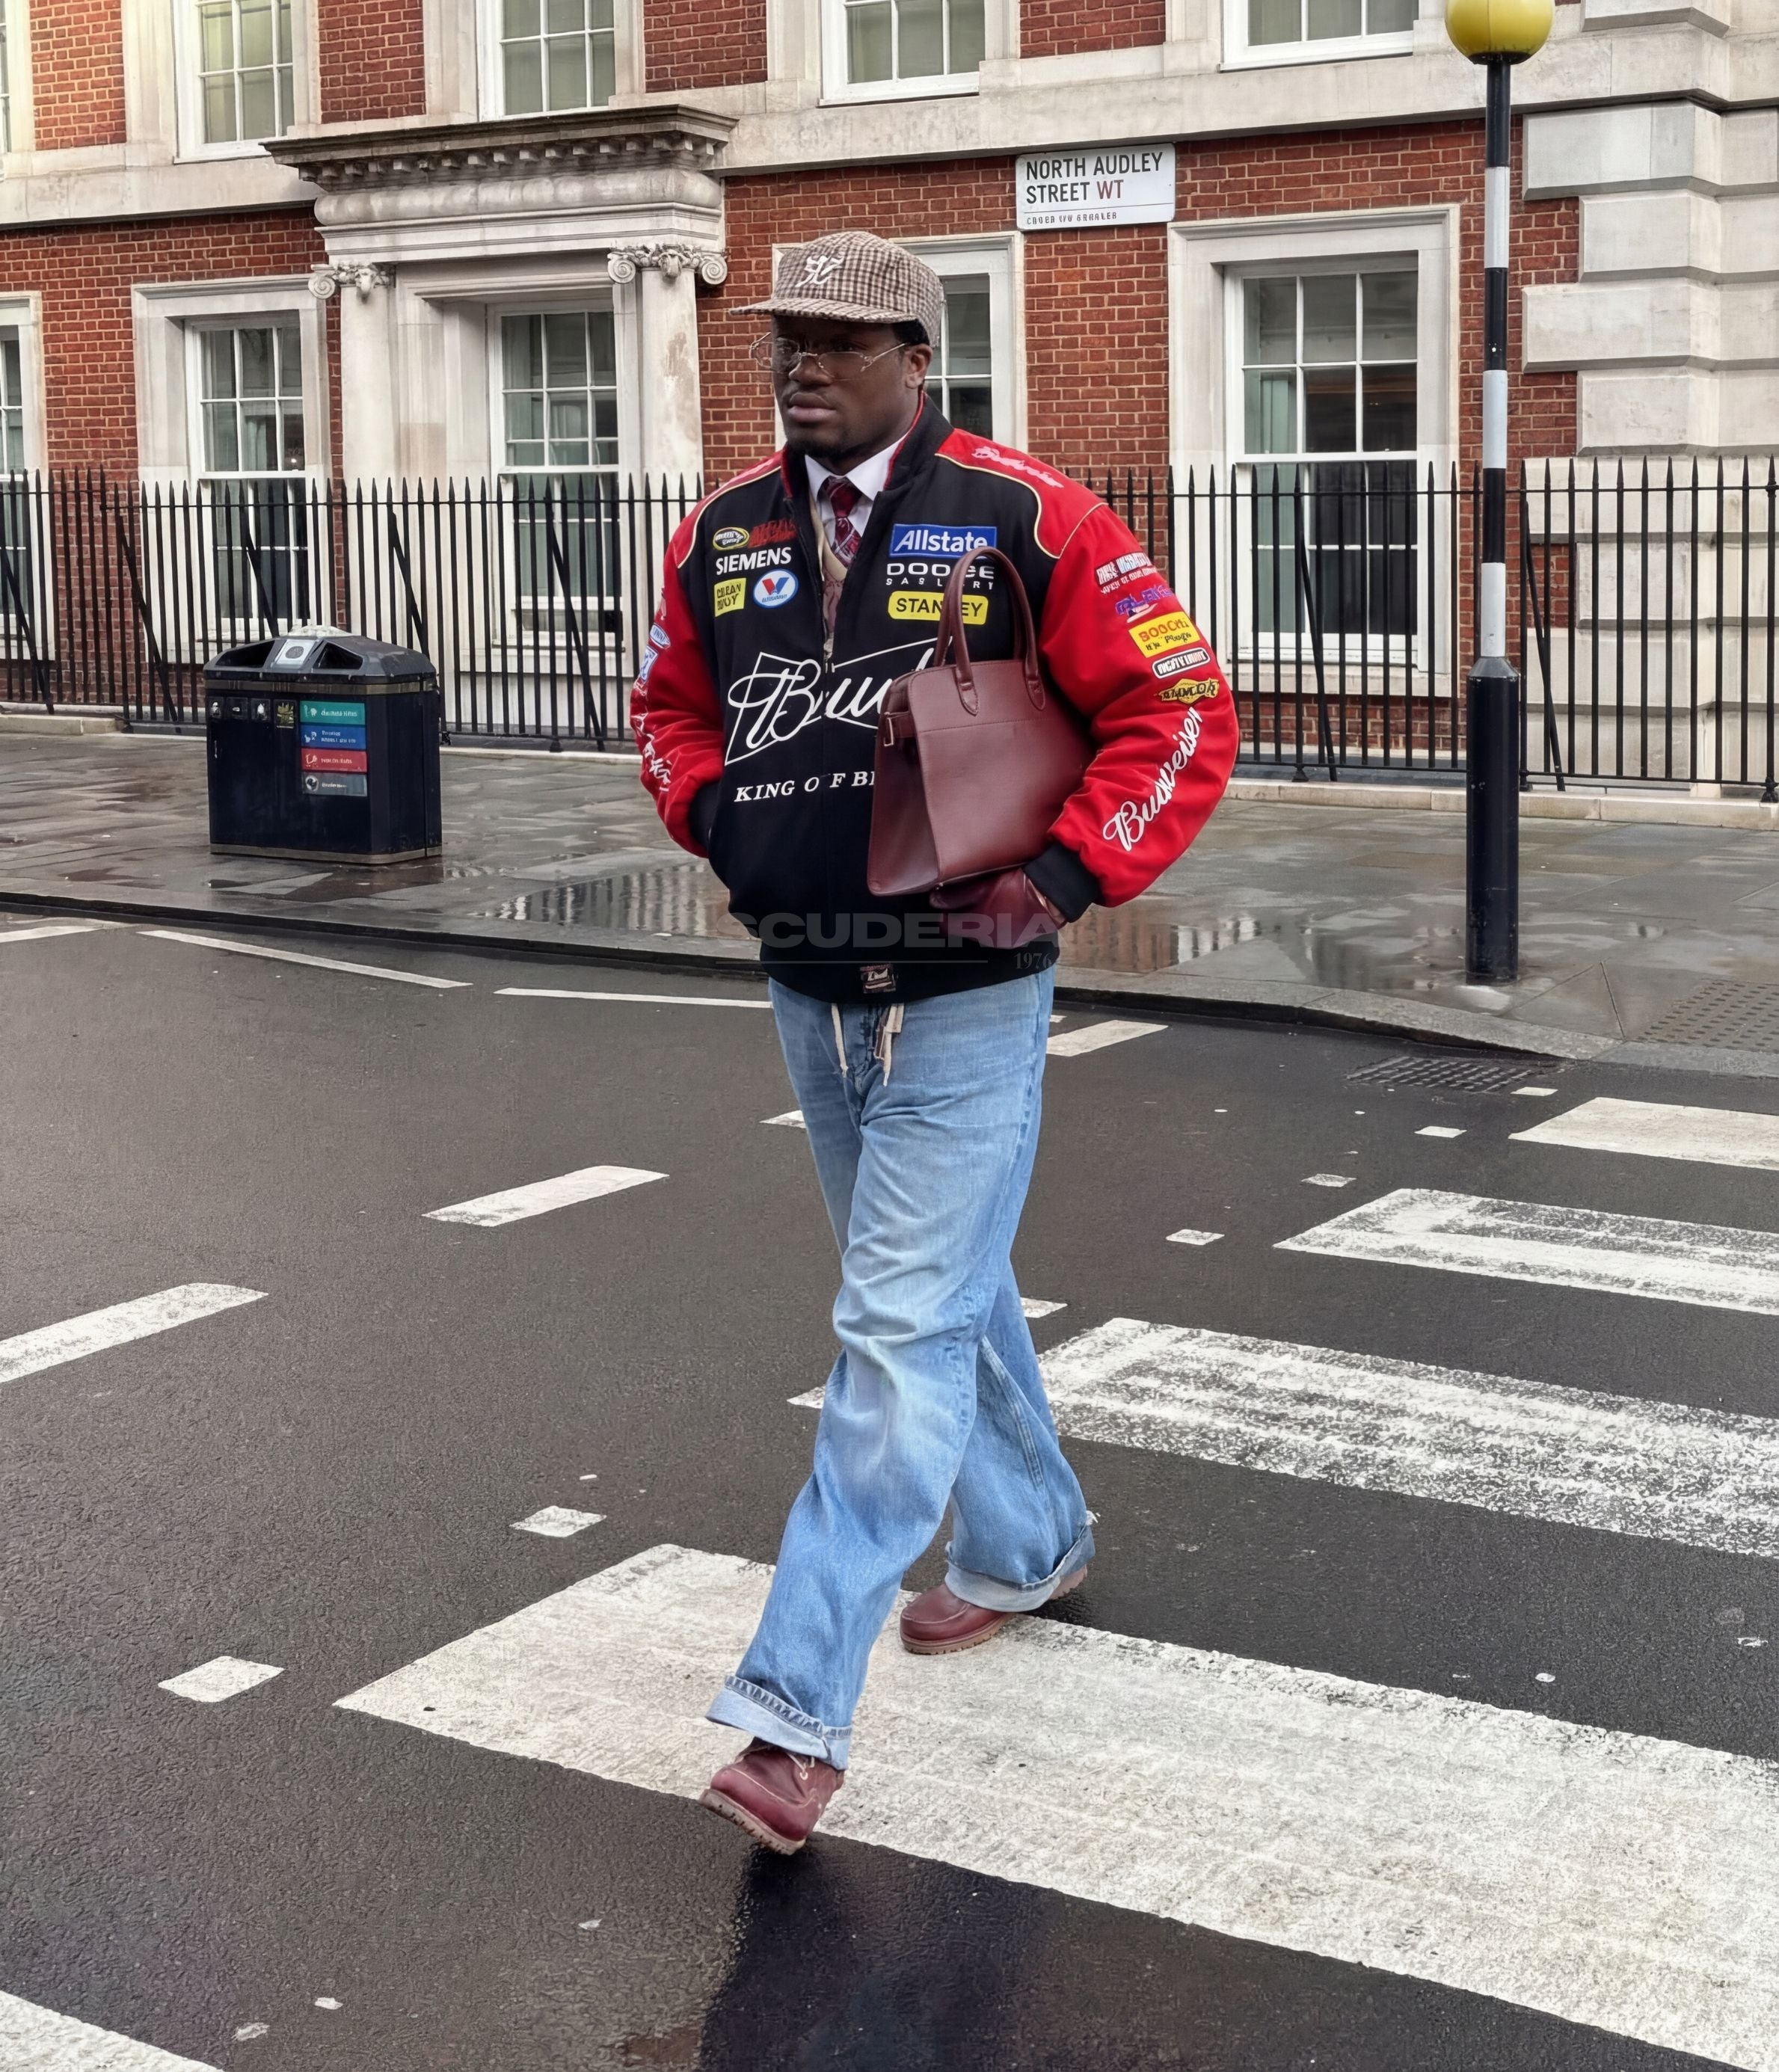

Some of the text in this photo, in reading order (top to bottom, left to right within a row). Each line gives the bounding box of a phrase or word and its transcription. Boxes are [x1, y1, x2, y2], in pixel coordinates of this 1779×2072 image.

[1026, 152, 1163, 180] NORTH AUDLEY
[1026, 182, 1090, 204] STREET
[894, 529, 988, 552] Allstate
[716, 547, 792, 575] SIEMENS
[896, 597, 983, 617] STANEY
[734, 780, 796, 802] KING
